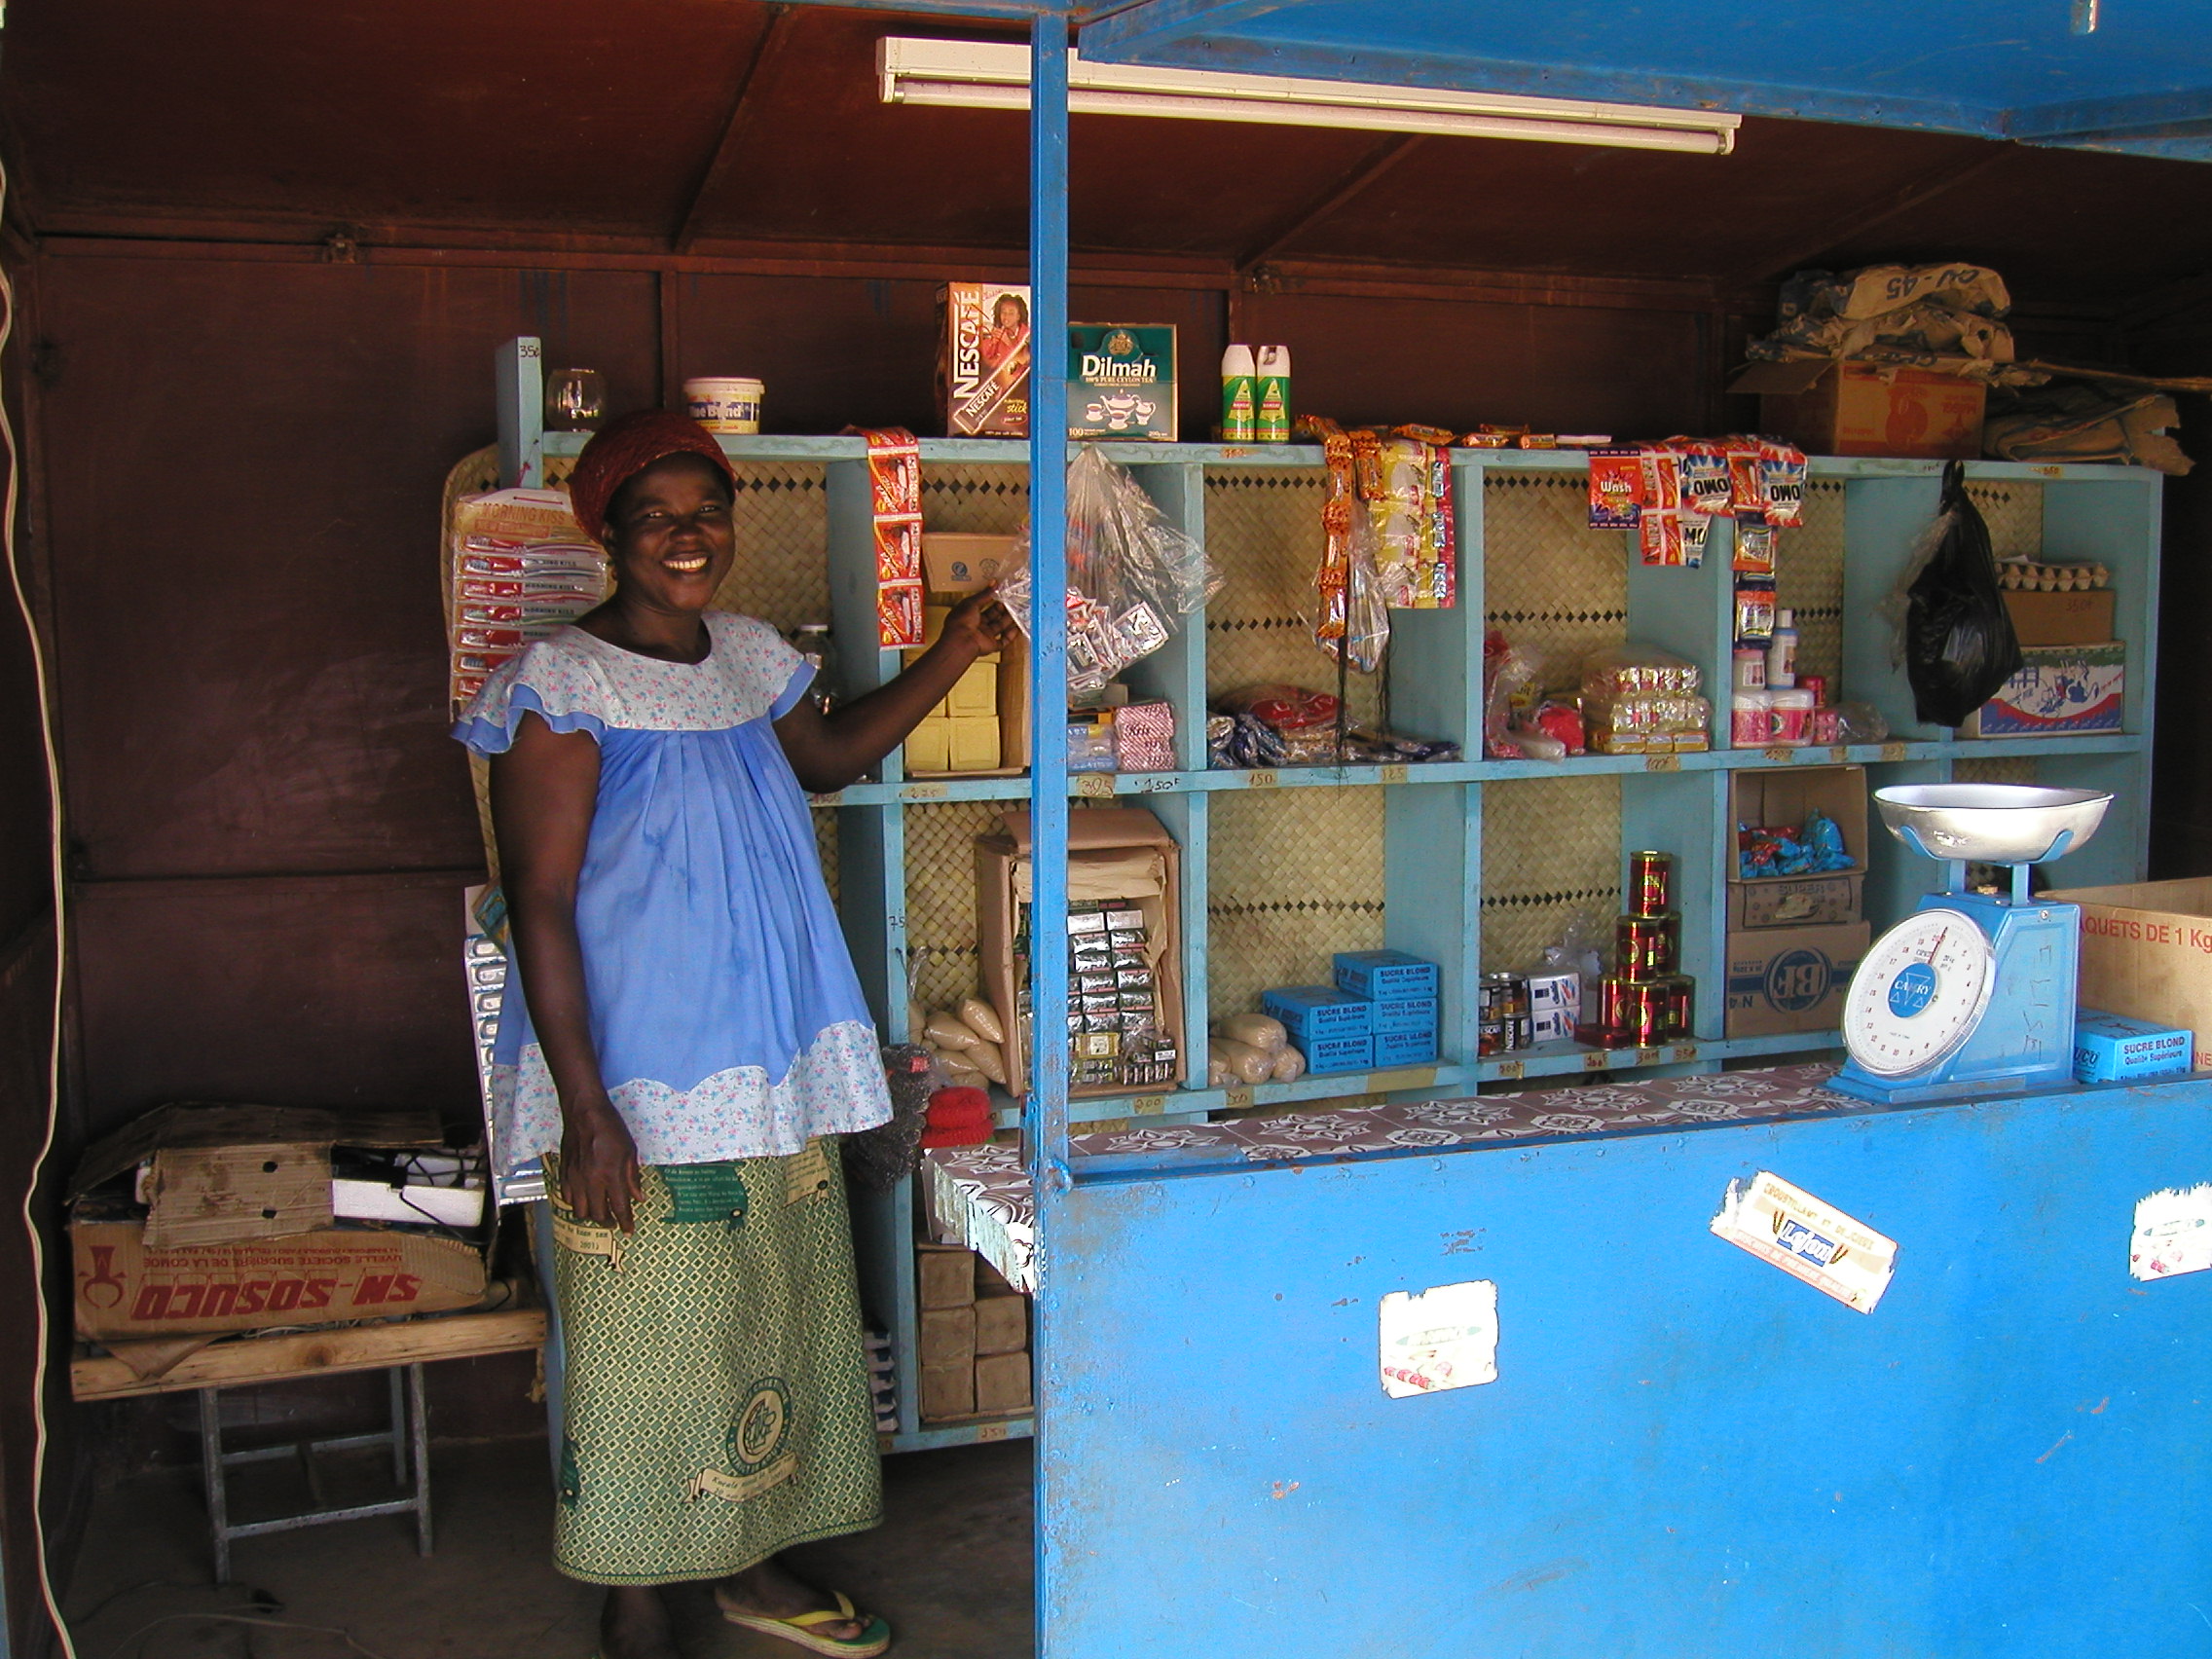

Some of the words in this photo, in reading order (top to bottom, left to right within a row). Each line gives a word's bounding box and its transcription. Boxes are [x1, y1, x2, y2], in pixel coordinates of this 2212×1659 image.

[1886, 276, 1919, 300] 45
[1082, 354, 1157, 378] Dilmah
[1069, 427, 1084, 437] 100
[1600, 481, 1633, 493] Wash
[1693, 478, 1729, 496] OMO
[1770, 485, 1801, 501] OMO
[538, 509, 566, 526] KISS
[1249, 773, 1273, 787] 150
[1778, 883, 1825, 895] SUPER
[2145, 924, 2170, 943] DE
[2175, 928, 2184, 944] 1
[2190, 928, 2212, 953] Kg
[1317, 1042, 1341, 1051] SUCRE
[2123, 1042, 2154, 1054] SUCRE
[2156, 1036, 2186, 1050] BLOND
